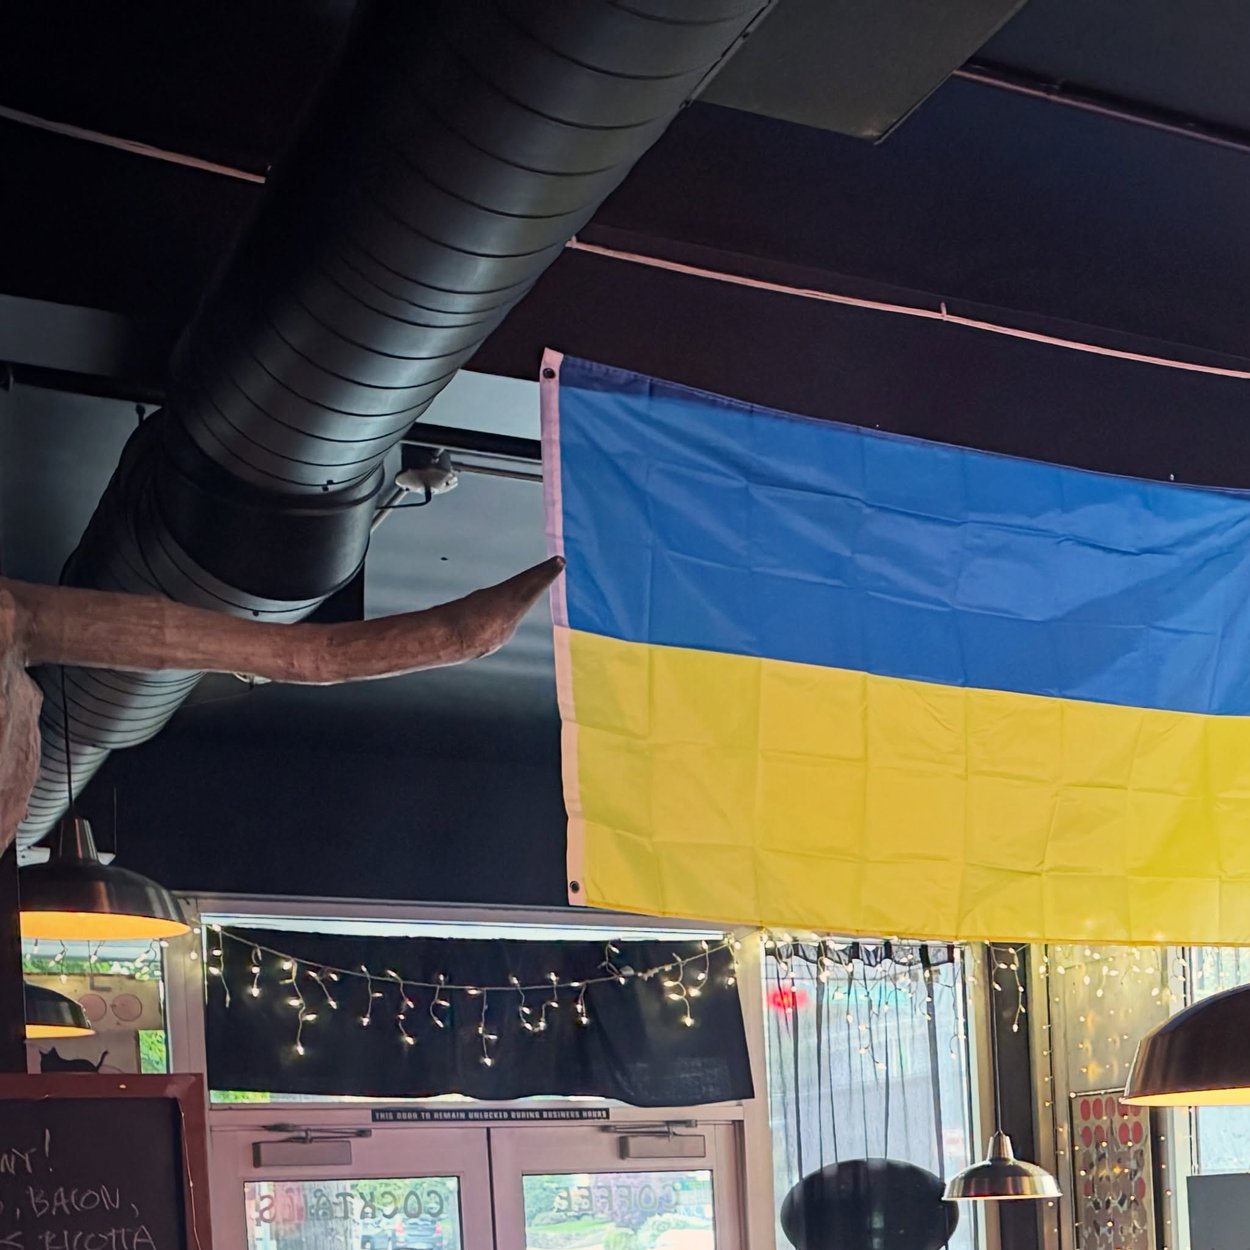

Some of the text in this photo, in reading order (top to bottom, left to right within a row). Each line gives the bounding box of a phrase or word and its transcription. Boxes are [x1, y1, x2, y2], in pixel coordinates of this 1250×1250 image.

[397, 1111, 418, 1120] DOOR
[421, 1111, 431, 1120] TO
[433, 1111, 466, 1120] REMAIN
[468, 1110, 508, 1119] UNLOCKED
[511, 1110, 540, 1119] DURING
[542, 1110, 580, 1119] BUSINESS
